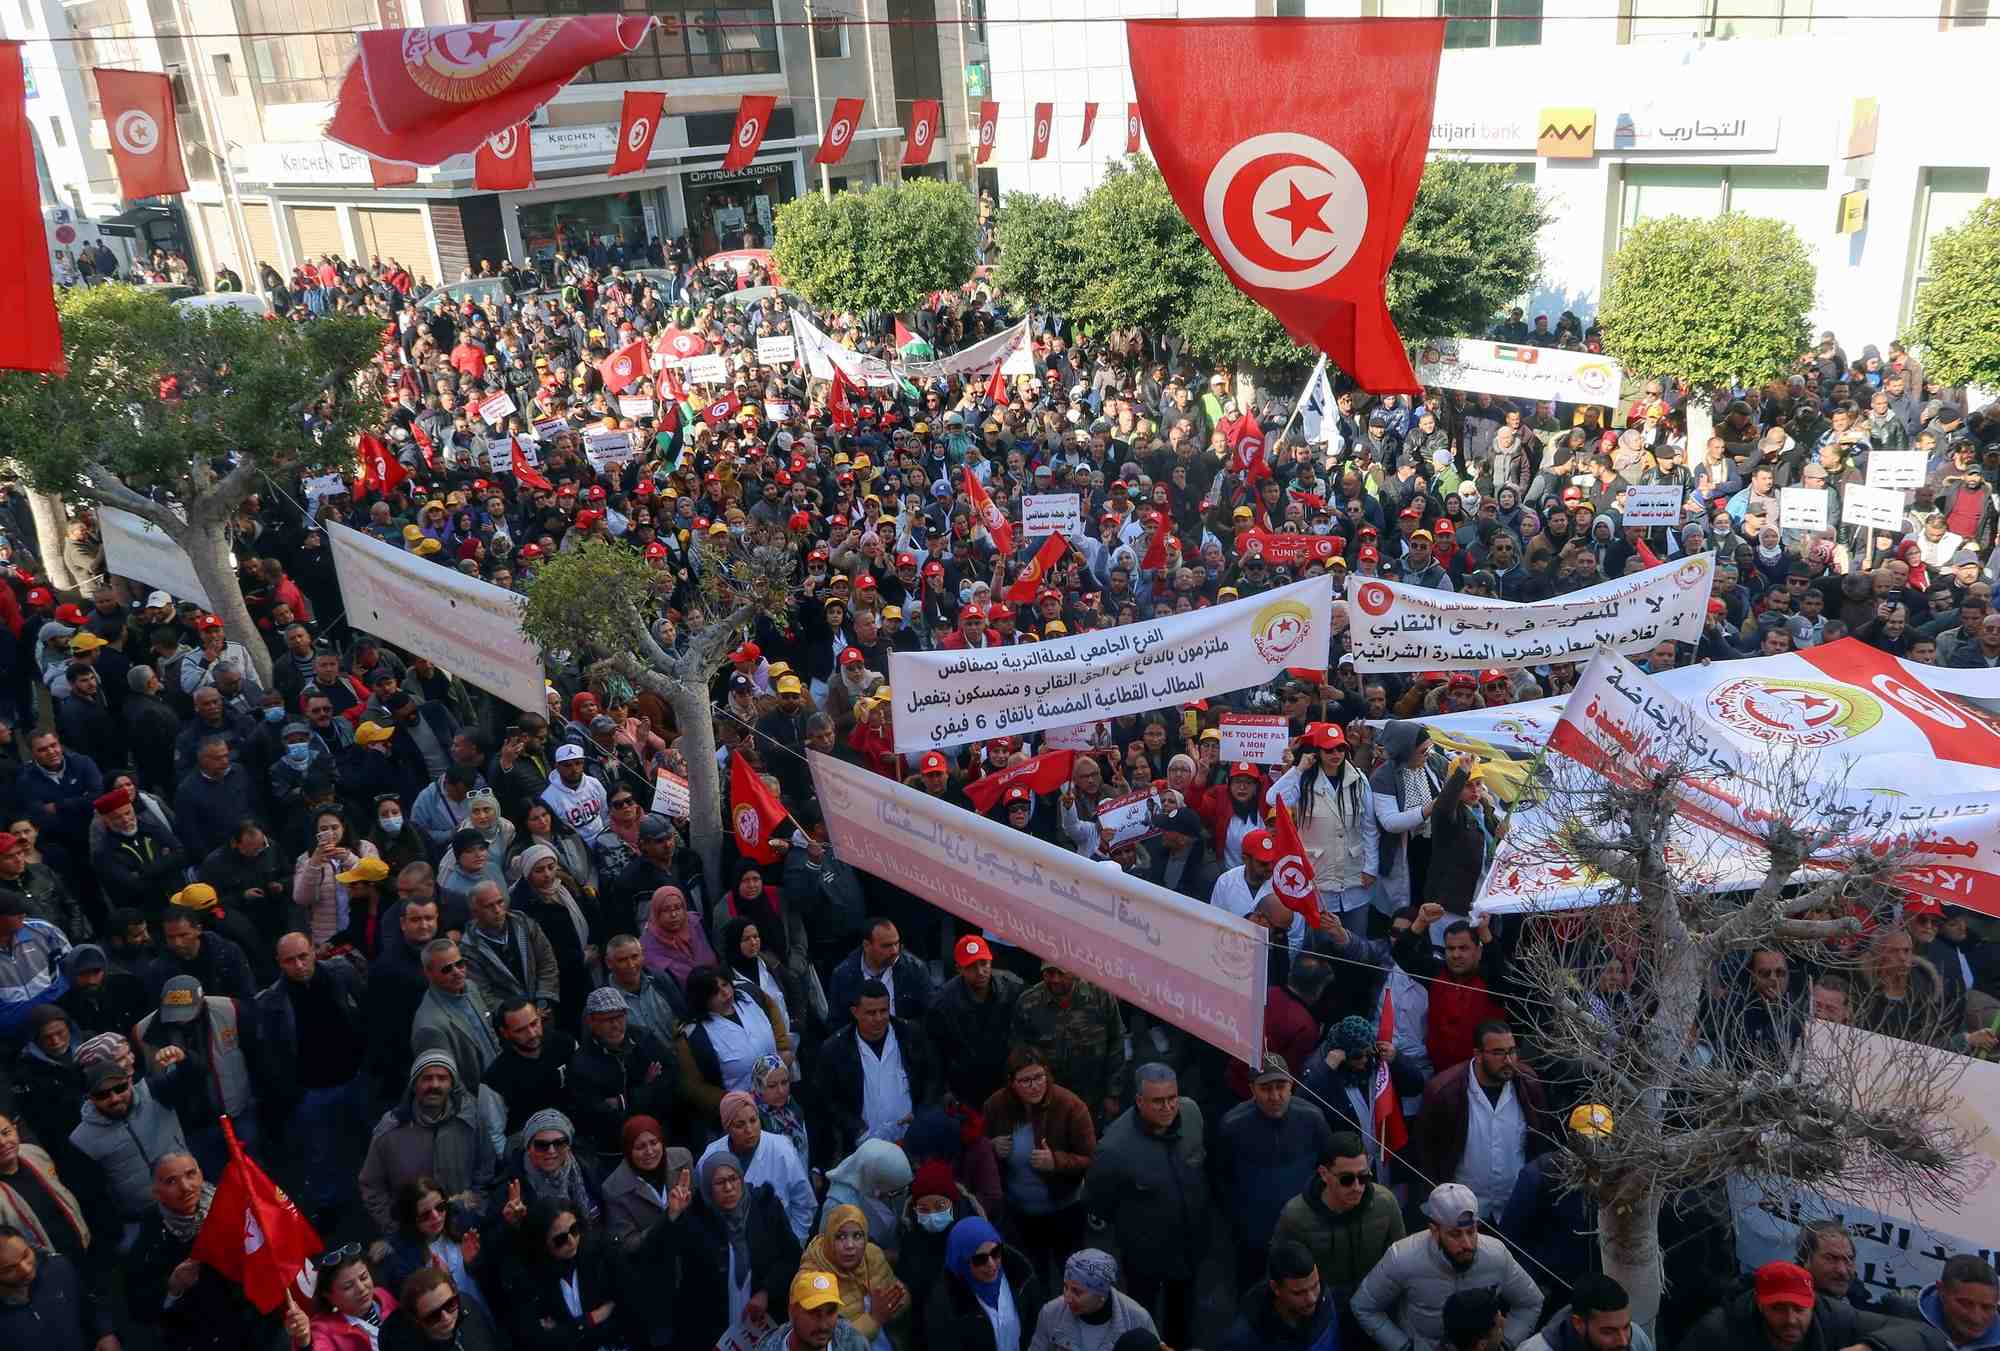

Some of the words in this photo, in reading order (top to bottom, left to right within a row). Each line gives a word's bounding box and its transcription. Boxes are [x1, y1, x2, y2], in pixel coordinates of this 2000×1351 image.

[549, 133, 596, 143] KRICHEN
[1430, 122, 1476, 142] ttijari
[1480, 119, 1521, 141] bank
[1658, 119, 1746, 141] التجاري
[281, 152, 334, 171] KRICHEN
[738, 164, 783, 177] KRICHEN
[1271, 549, 1310, 559] TUNISE
[1369, 614, 1442, 639] النقابي
[1449, 617, 1499, 636] الحق
[1504, 618, 1536, 637] في
[1618, 623, 1659, 644] لغلاء
[1080, 635, 1130, 667] الجامعي
[1132, 627, 1164, 654] الفرع
[1178, 635, 1229, 665] ملتزمون
[1501, 638, 1553, 661] وضرب
[1133, 649, 1174, 675] بالدفاع
[1431, 643, 1495, 663] المقدرة
[937, 656, 999, 679] بصفاقس
[1079, 667, 1110, 686] الحق
[1112, 663, 1131, 677] عن
[954, 682, 1020, 706] متمسكون
[1035, 671, 1077, 699] النقابي
[1095, 681, 1148, 711] القطاعية
[1151, 671, 1205, 702] المطالب
[906, 687, 951, 713] بتفعيل
[1036, 691, 1092, 718] المضمنة
[975, 713, 987, 729] 6
[995, 703, 1034, 730] باتفاق
[930, 712, 970, 747] فيفري
[1235, 731, 1269, 739] TOUCHE
[1247, 741, 1266, 749] MON
